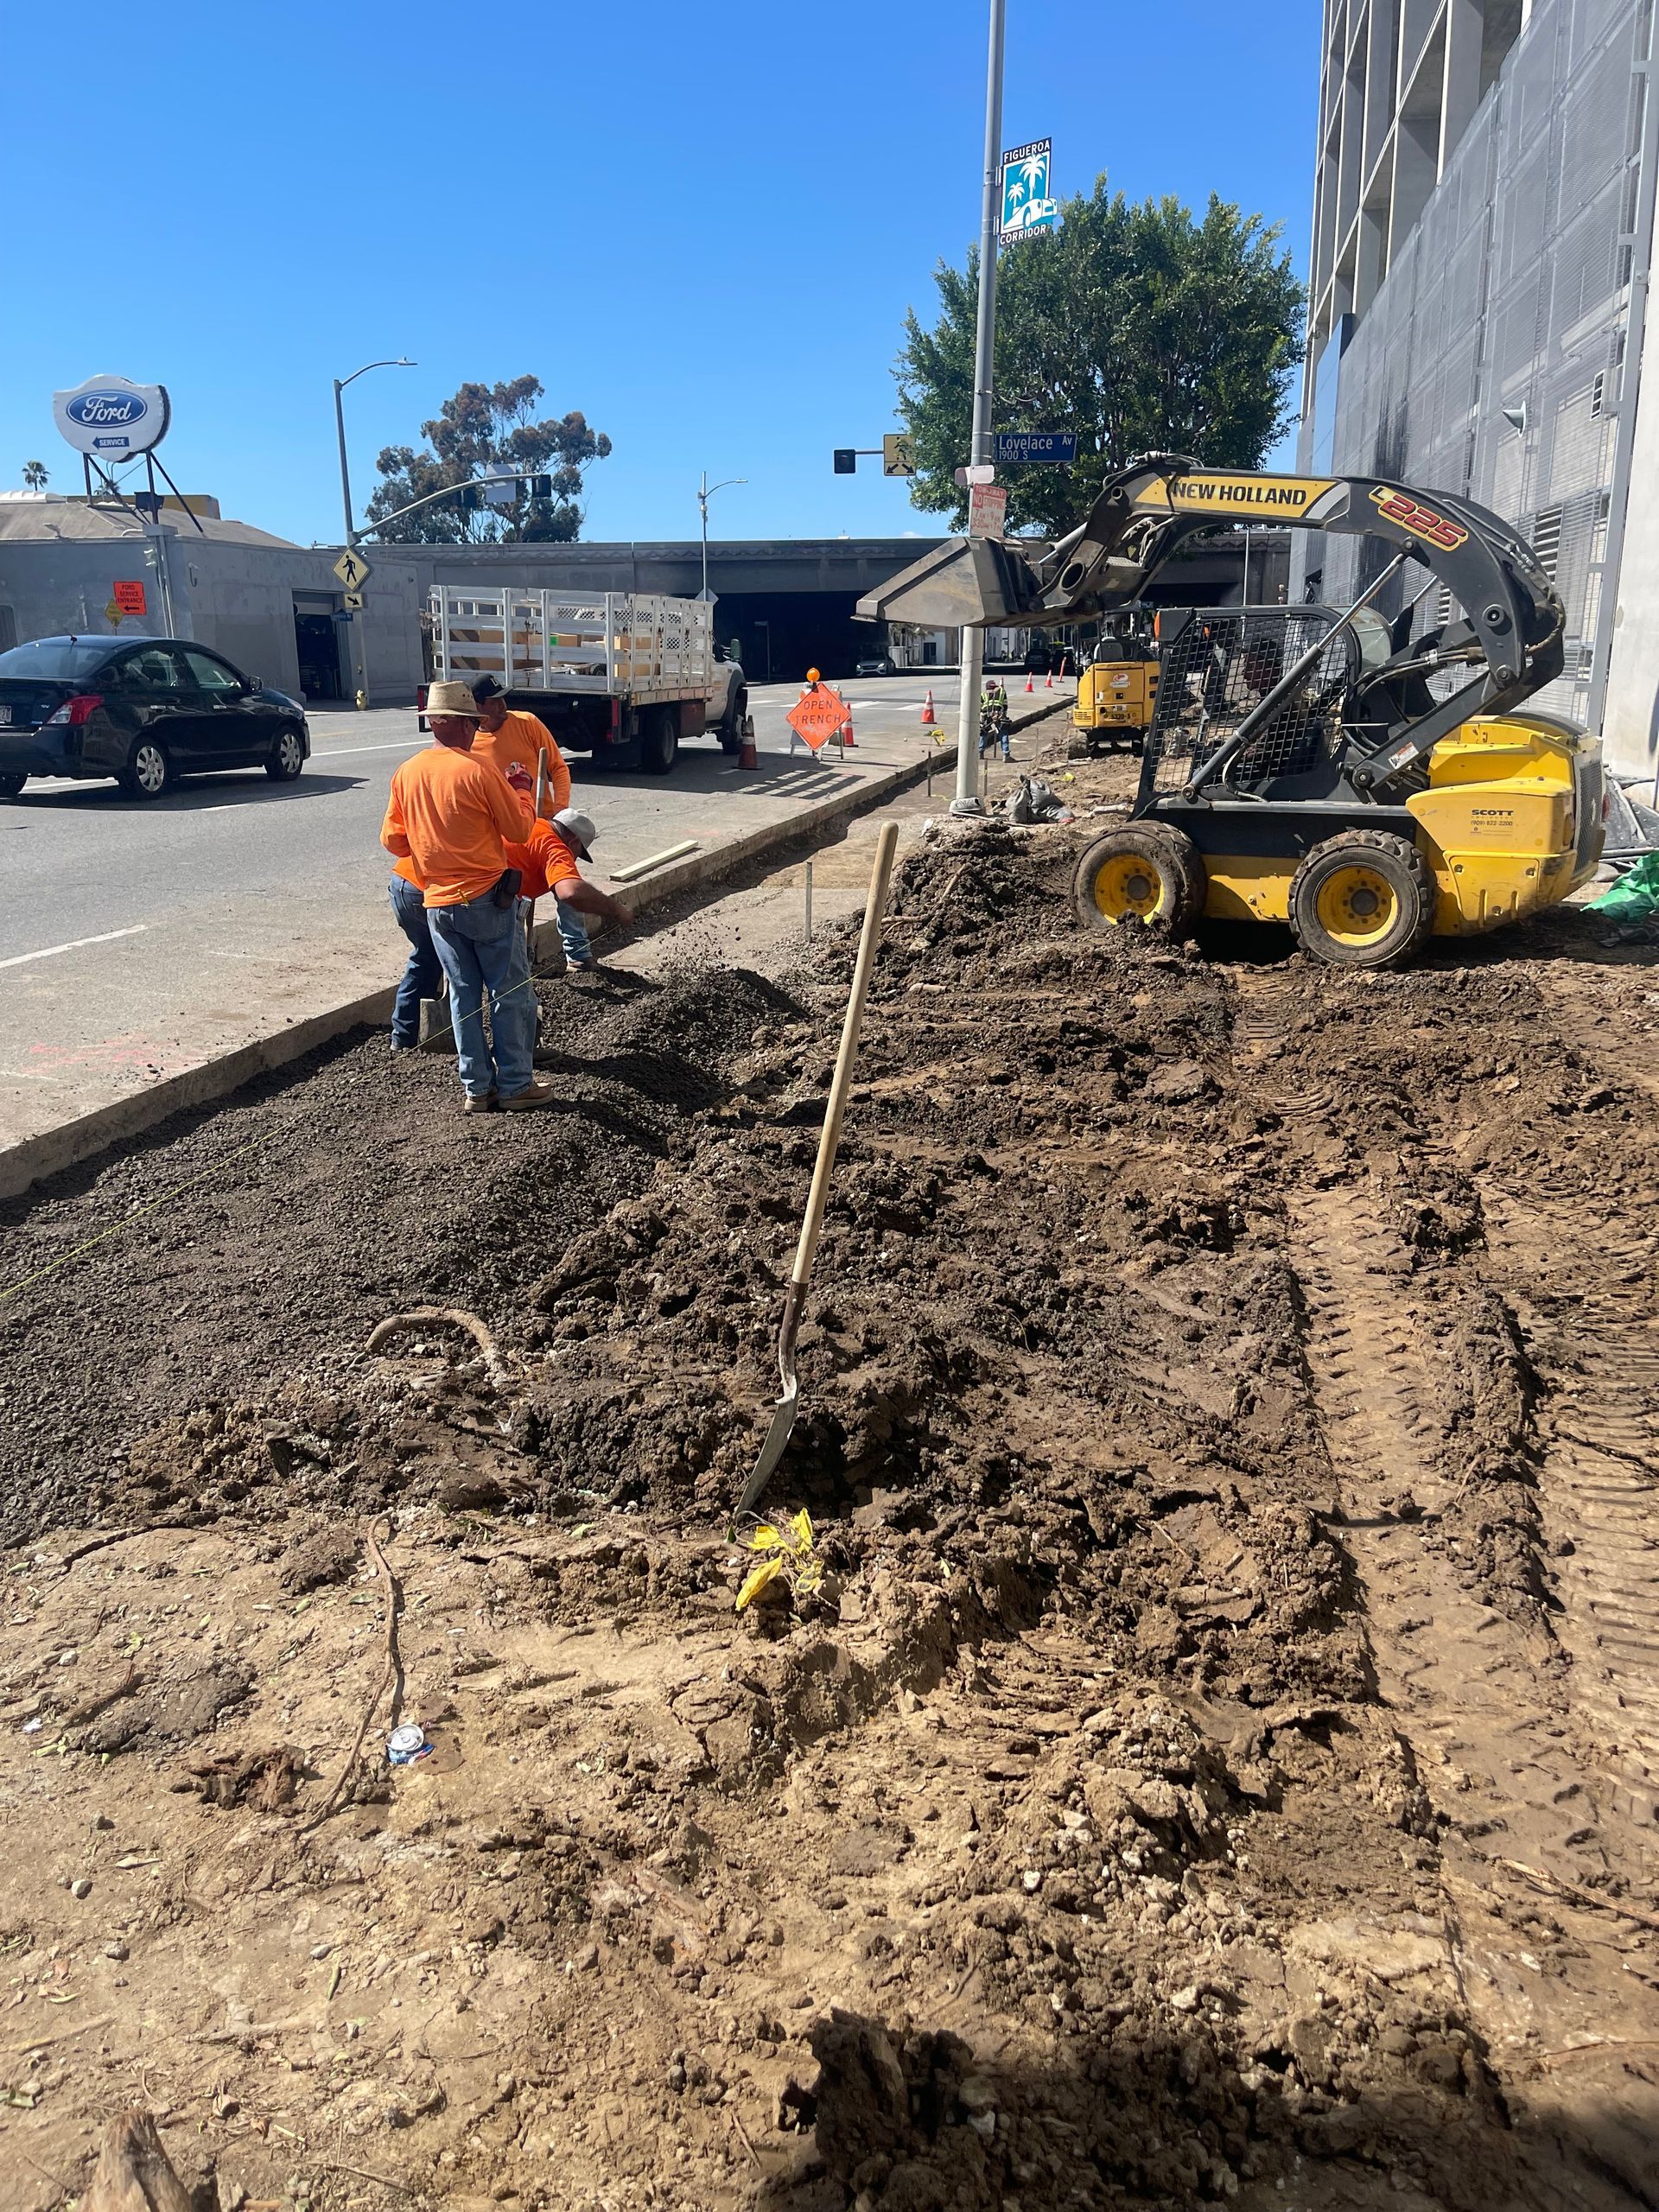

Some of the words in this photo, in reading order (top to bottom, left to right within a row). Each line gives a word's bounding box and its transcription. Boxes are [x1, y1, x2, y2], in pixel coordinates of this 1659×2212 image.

[1004, 139, 1050, 163] FIGUEROA
[1000, 224, 1046, 245] CORRIDOR
[81, 397, 131, 422] Ford
[99, 437, 125, 447] SERVICE
[999, 435, 1053, 450] Lovelace
[1062, 435, 1072, 446] Av
[999, 450, 1019, 461] 1900
[1023, 448, 1028, 460] S
[974, 493, 982, 506] NO
[1173, 482, 1215, 499] NEW
[1219, 485, 1306, 505] HOLLAND
[804, 700, 833, 710] OPEN
[796, 714, 842, 727] TRENCH
